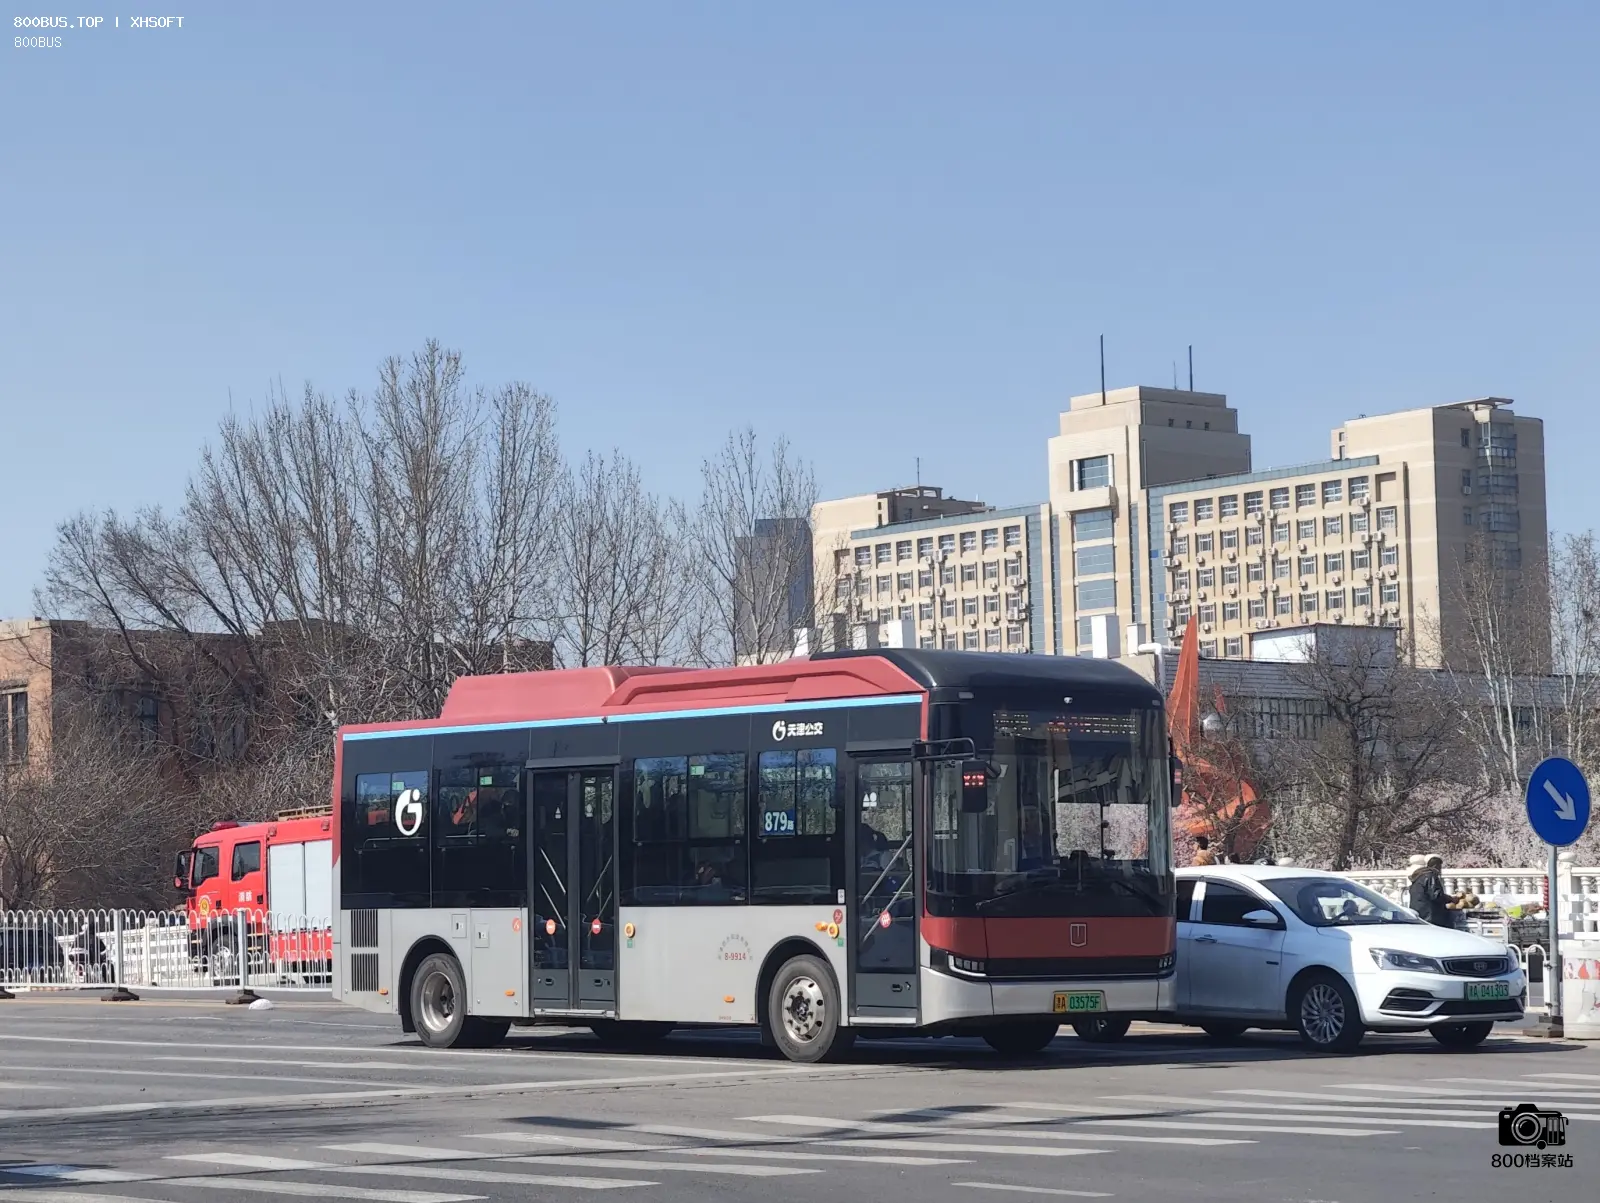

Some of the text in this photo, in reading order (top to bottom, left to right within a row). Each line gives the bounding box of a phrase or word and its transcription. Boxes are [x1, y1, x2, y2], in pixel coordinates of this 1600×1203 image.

[787, 721, 824, 737] 天津公交
[724, 952, 747, 961] 8-9914
[1069, 995, 1101, 1010] 03575F
